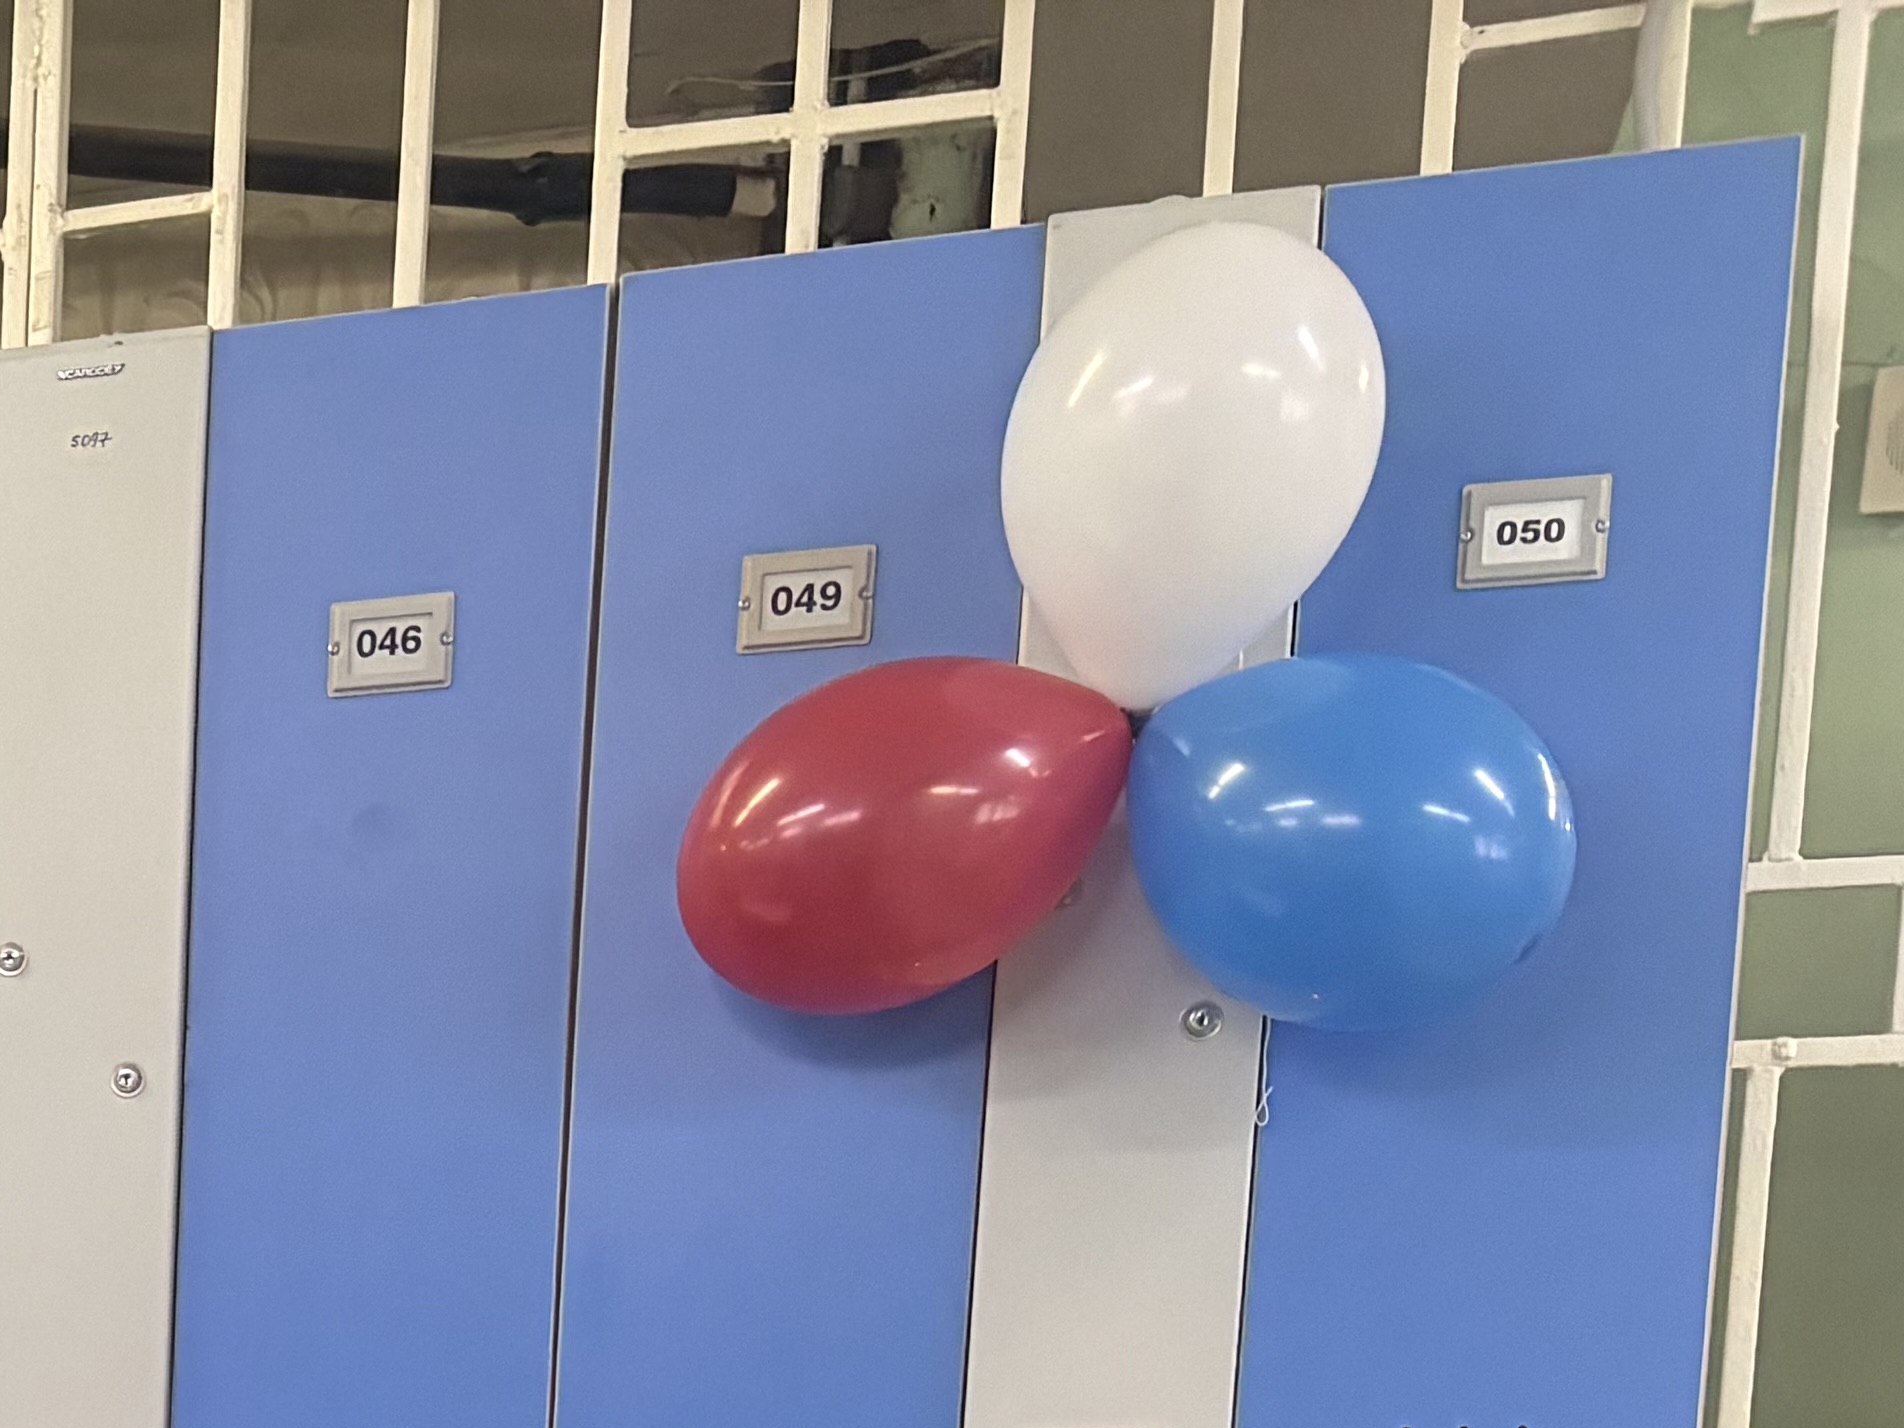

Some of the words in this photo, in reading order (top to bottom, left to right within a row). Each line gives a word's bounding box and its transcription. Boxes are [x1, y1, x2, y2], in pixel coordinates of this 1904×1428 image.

[1495, 517, 1567, 547] 050
[770, 581, 843, 616] 049
[355, 623, 423, 660] 046
